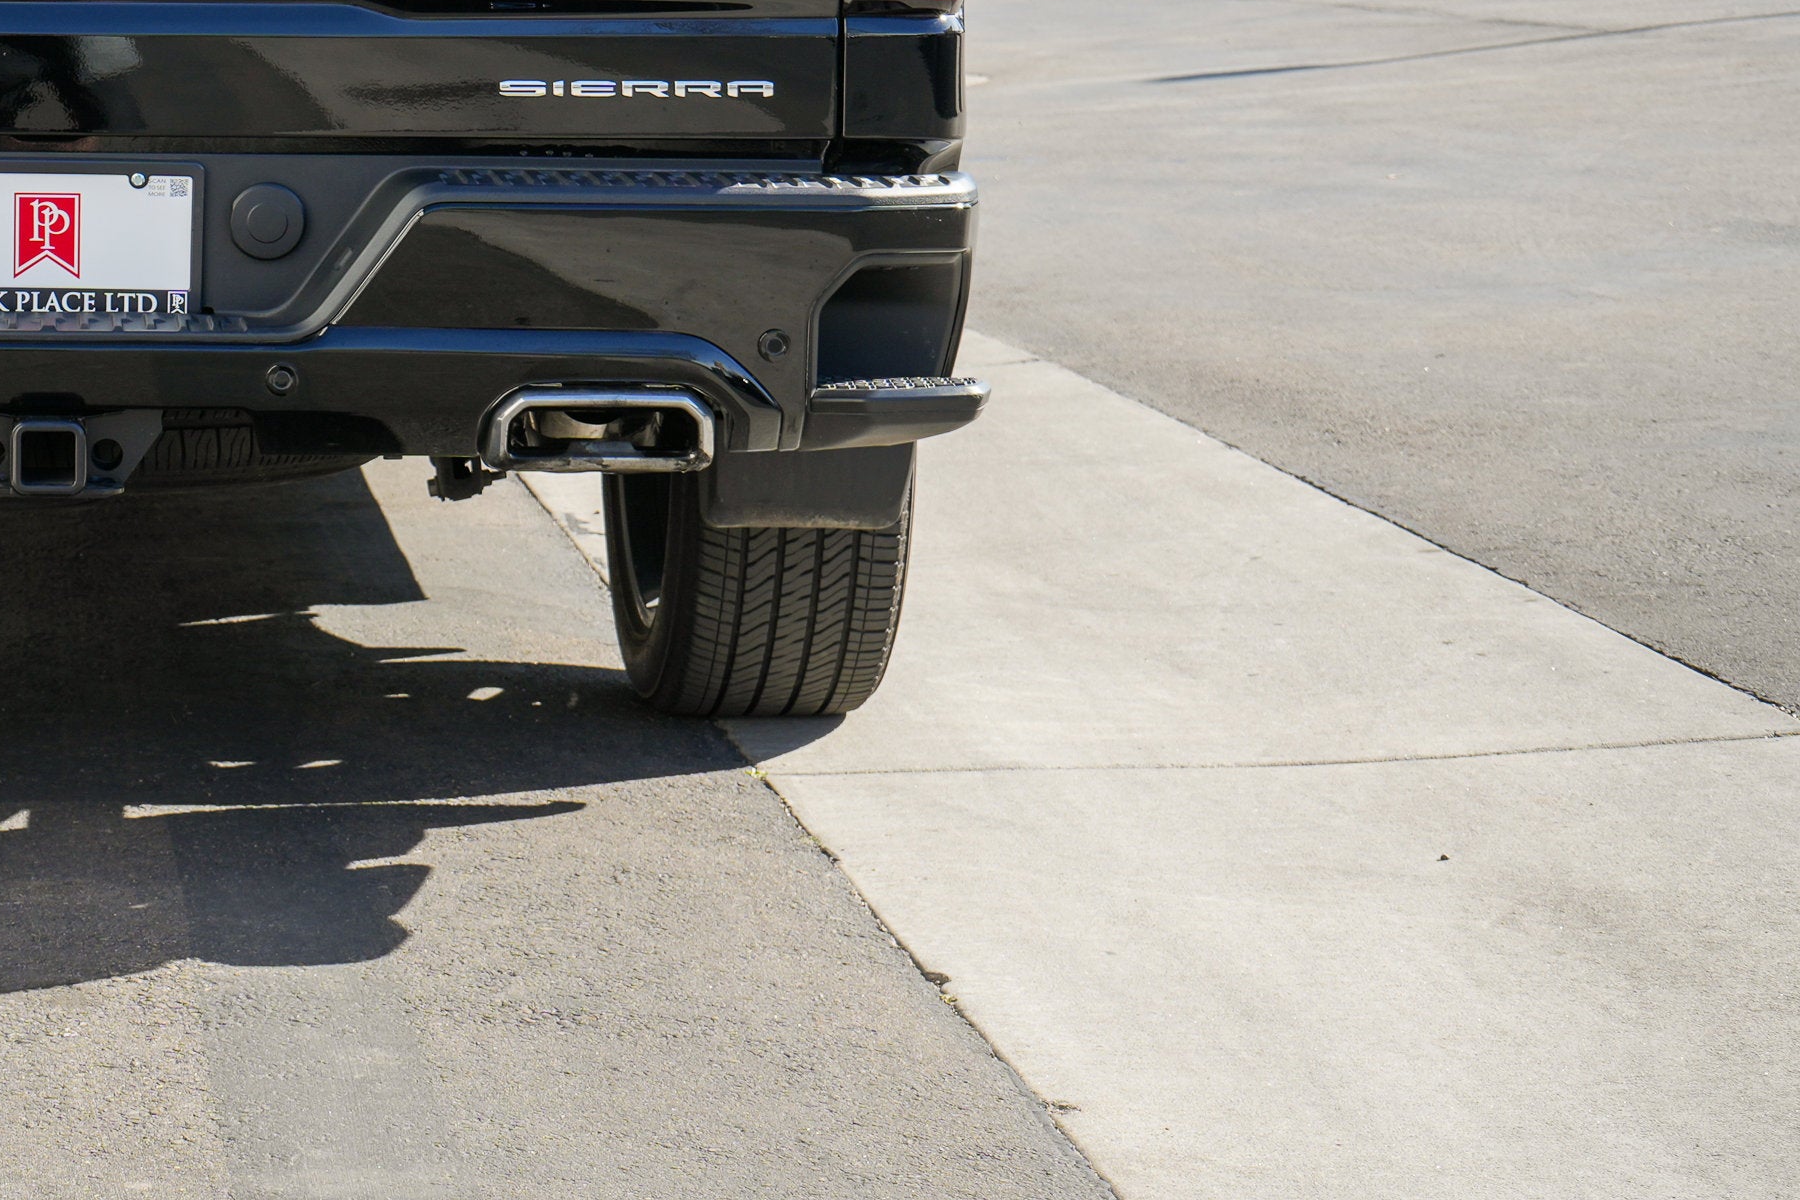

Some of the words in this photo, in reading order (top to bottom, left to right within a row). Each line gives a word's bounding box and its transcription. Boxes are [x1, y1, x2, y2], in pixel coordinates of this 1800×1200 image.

[499, 80, 774, 98] SIERRA
[15, 291, 96, 313] PLACE
[104, 292, 158, 313] LTD
